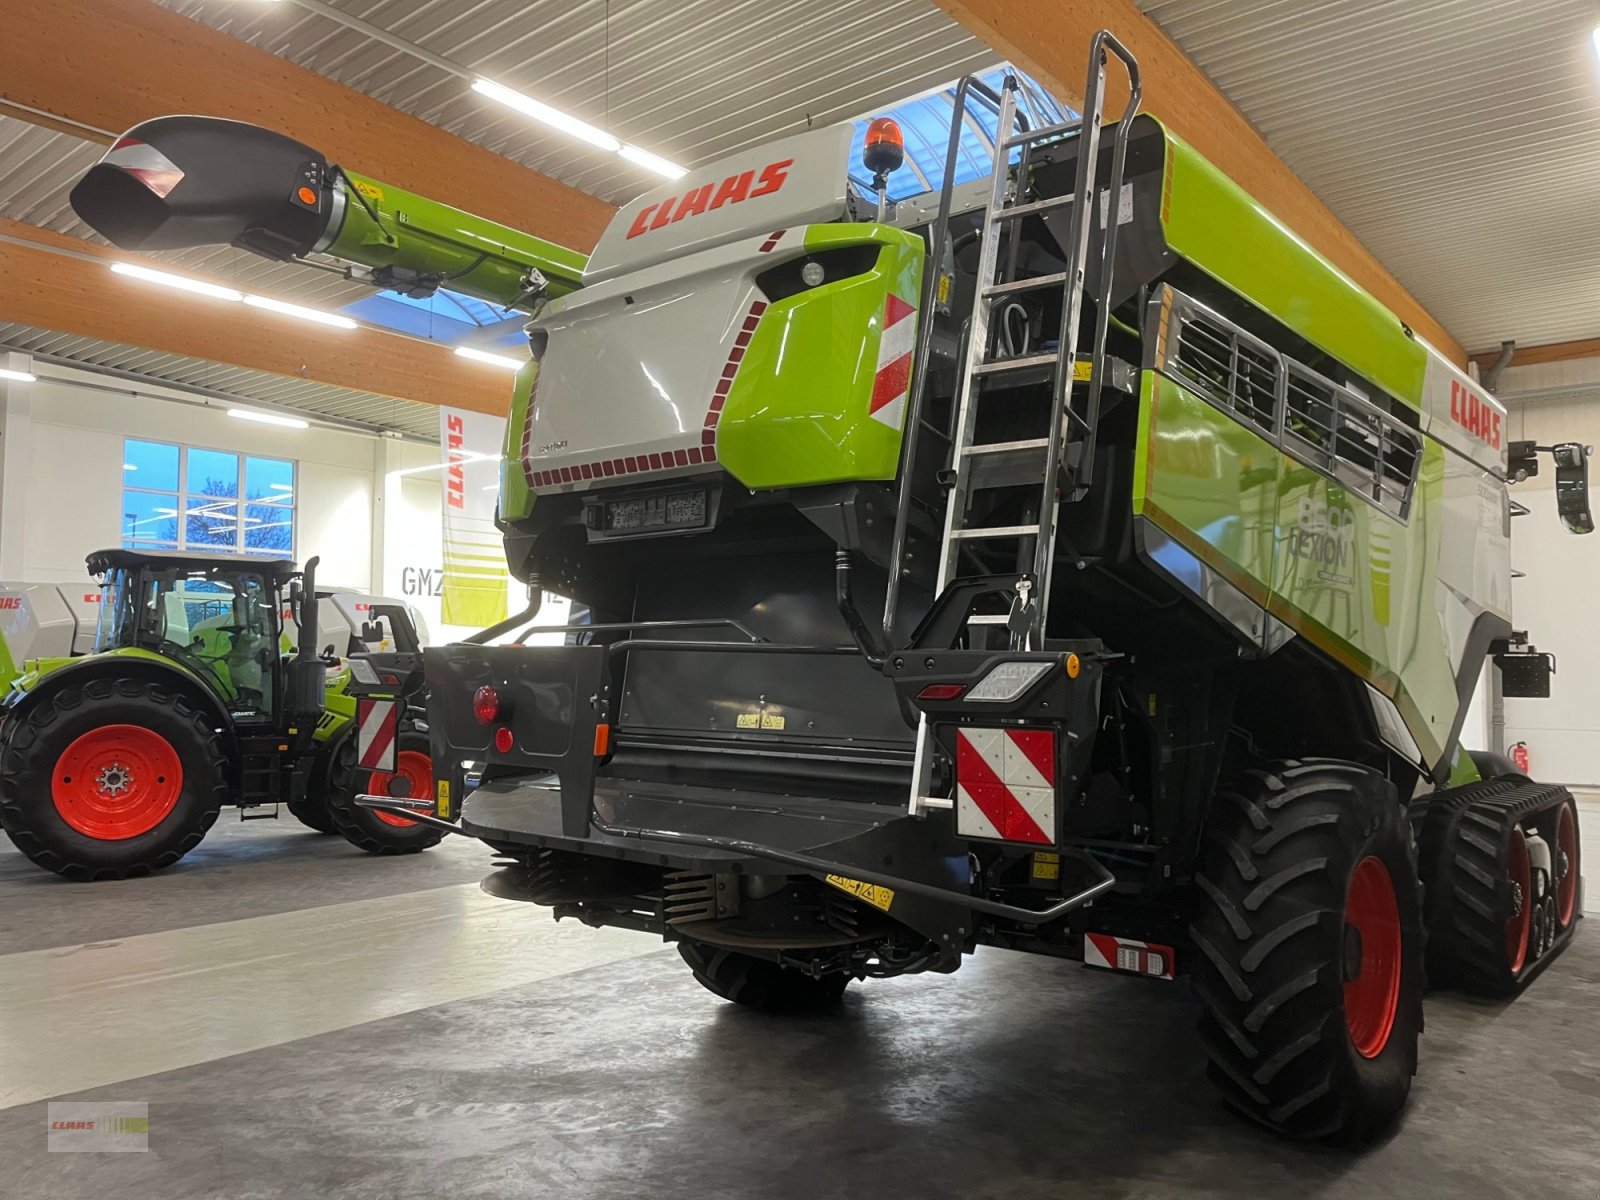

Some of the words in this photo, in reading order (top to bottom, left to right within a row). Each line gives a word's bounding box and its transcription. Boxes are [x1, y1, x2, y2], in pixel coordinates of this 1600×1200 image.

[626, 158, 795, 240] CLAAS
[1451, 379, 1502, 451] CLAAS
[447, 413, 464, 510] CLAAS
